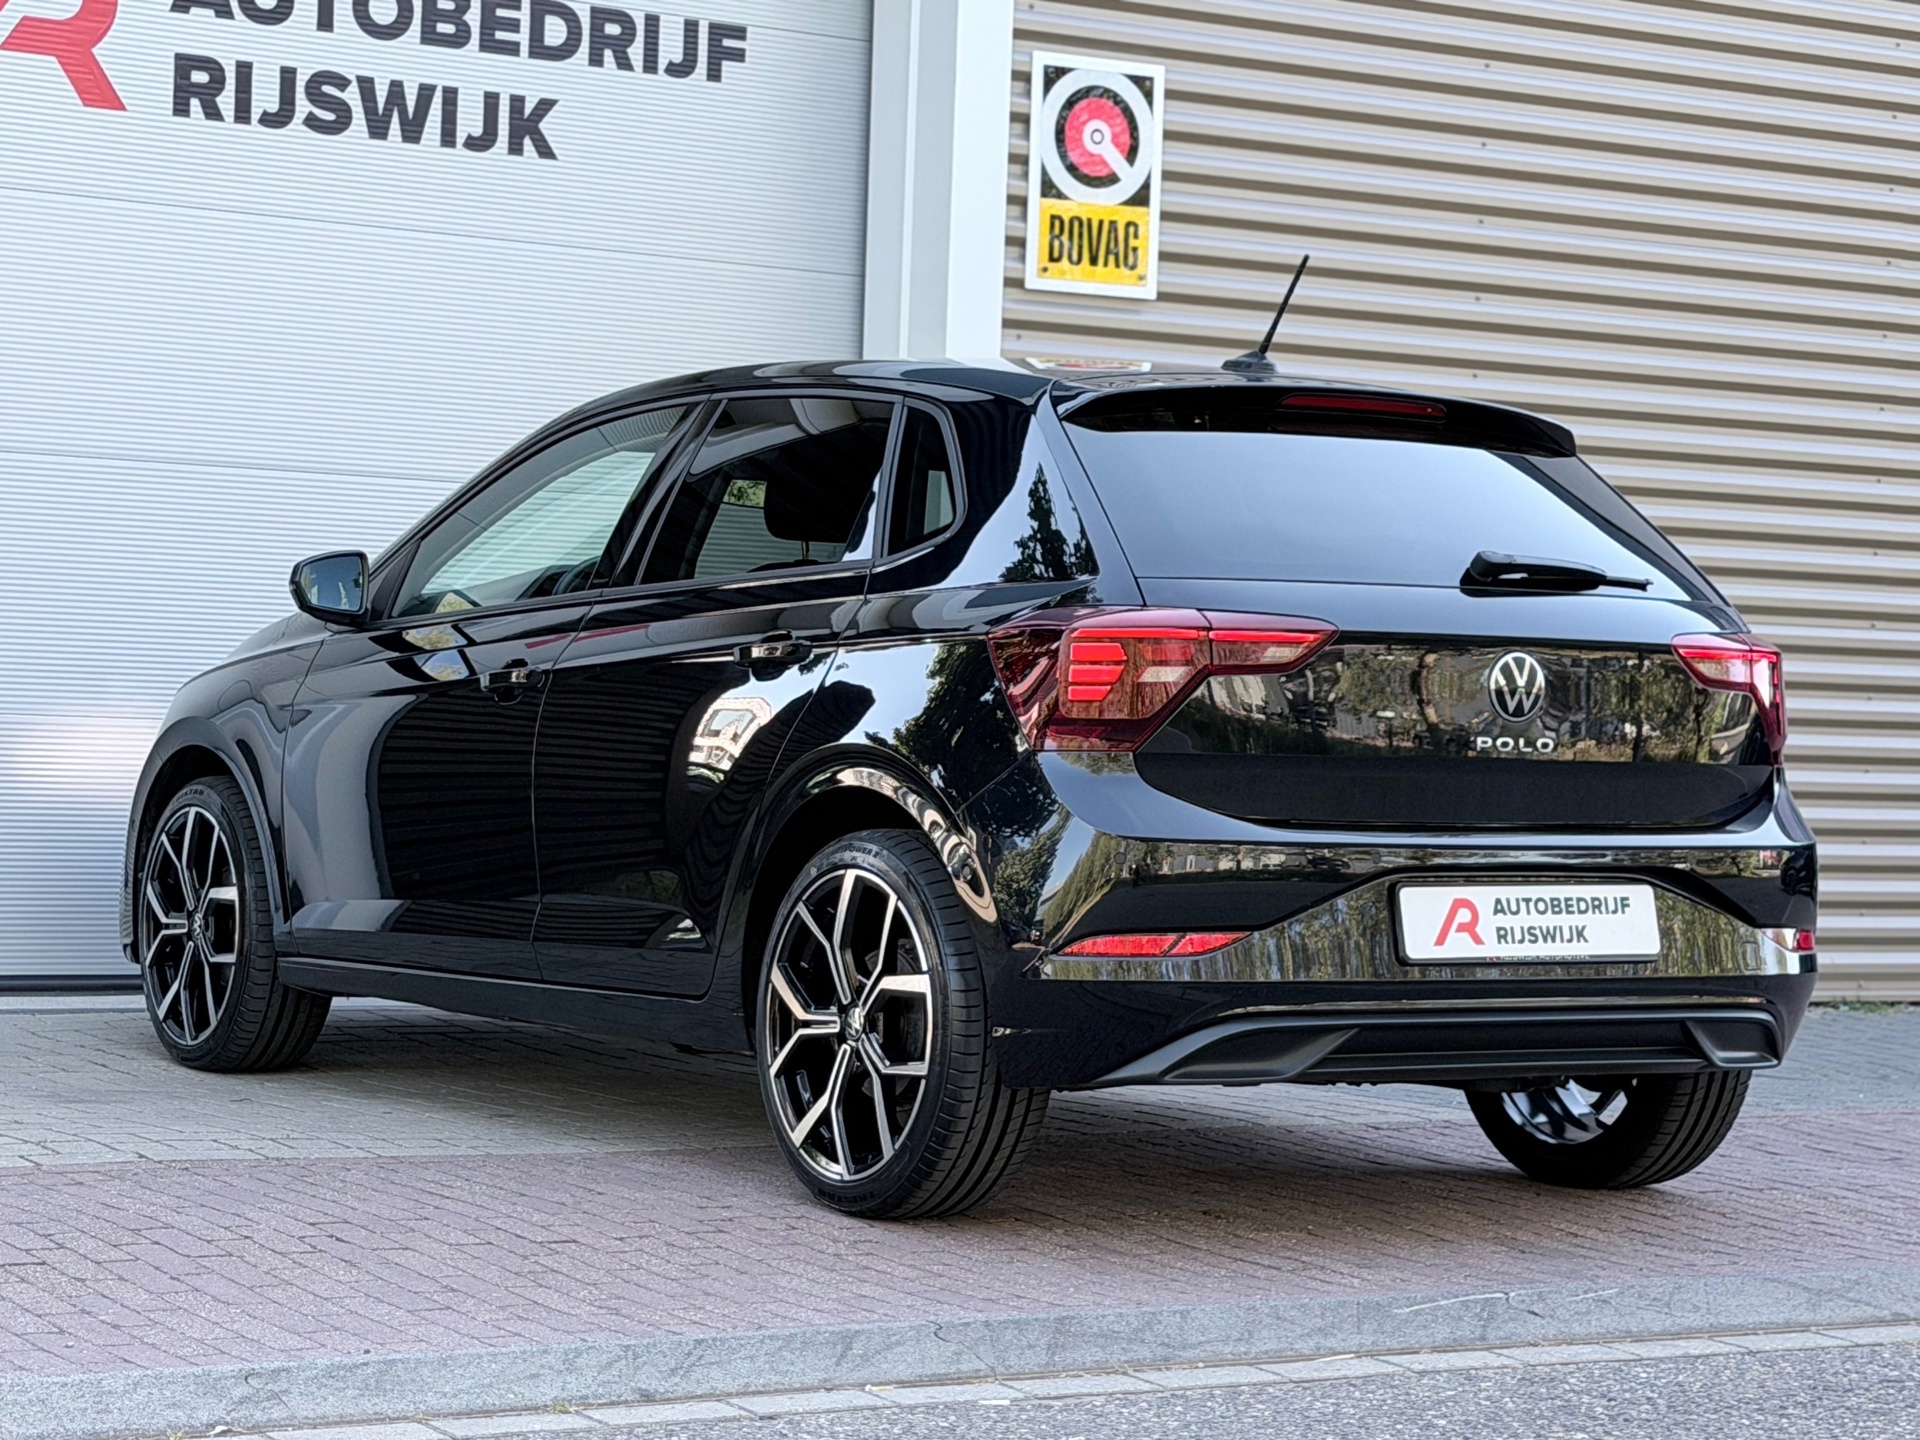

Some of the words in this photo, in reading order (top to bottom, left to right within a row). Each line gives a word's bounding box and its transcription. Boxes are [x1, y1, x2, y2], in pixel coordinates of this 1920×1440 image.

[172, 52, 560, 161] RIJSWIJK
[1048, 213, 1140, 271] BOVAG
[1476, 736, 1555, 753] POLO
[1492, 896, 1631, 916] AUTOBEDRIJF
[1495, 924, 1589, 945] RIJSWIJK
